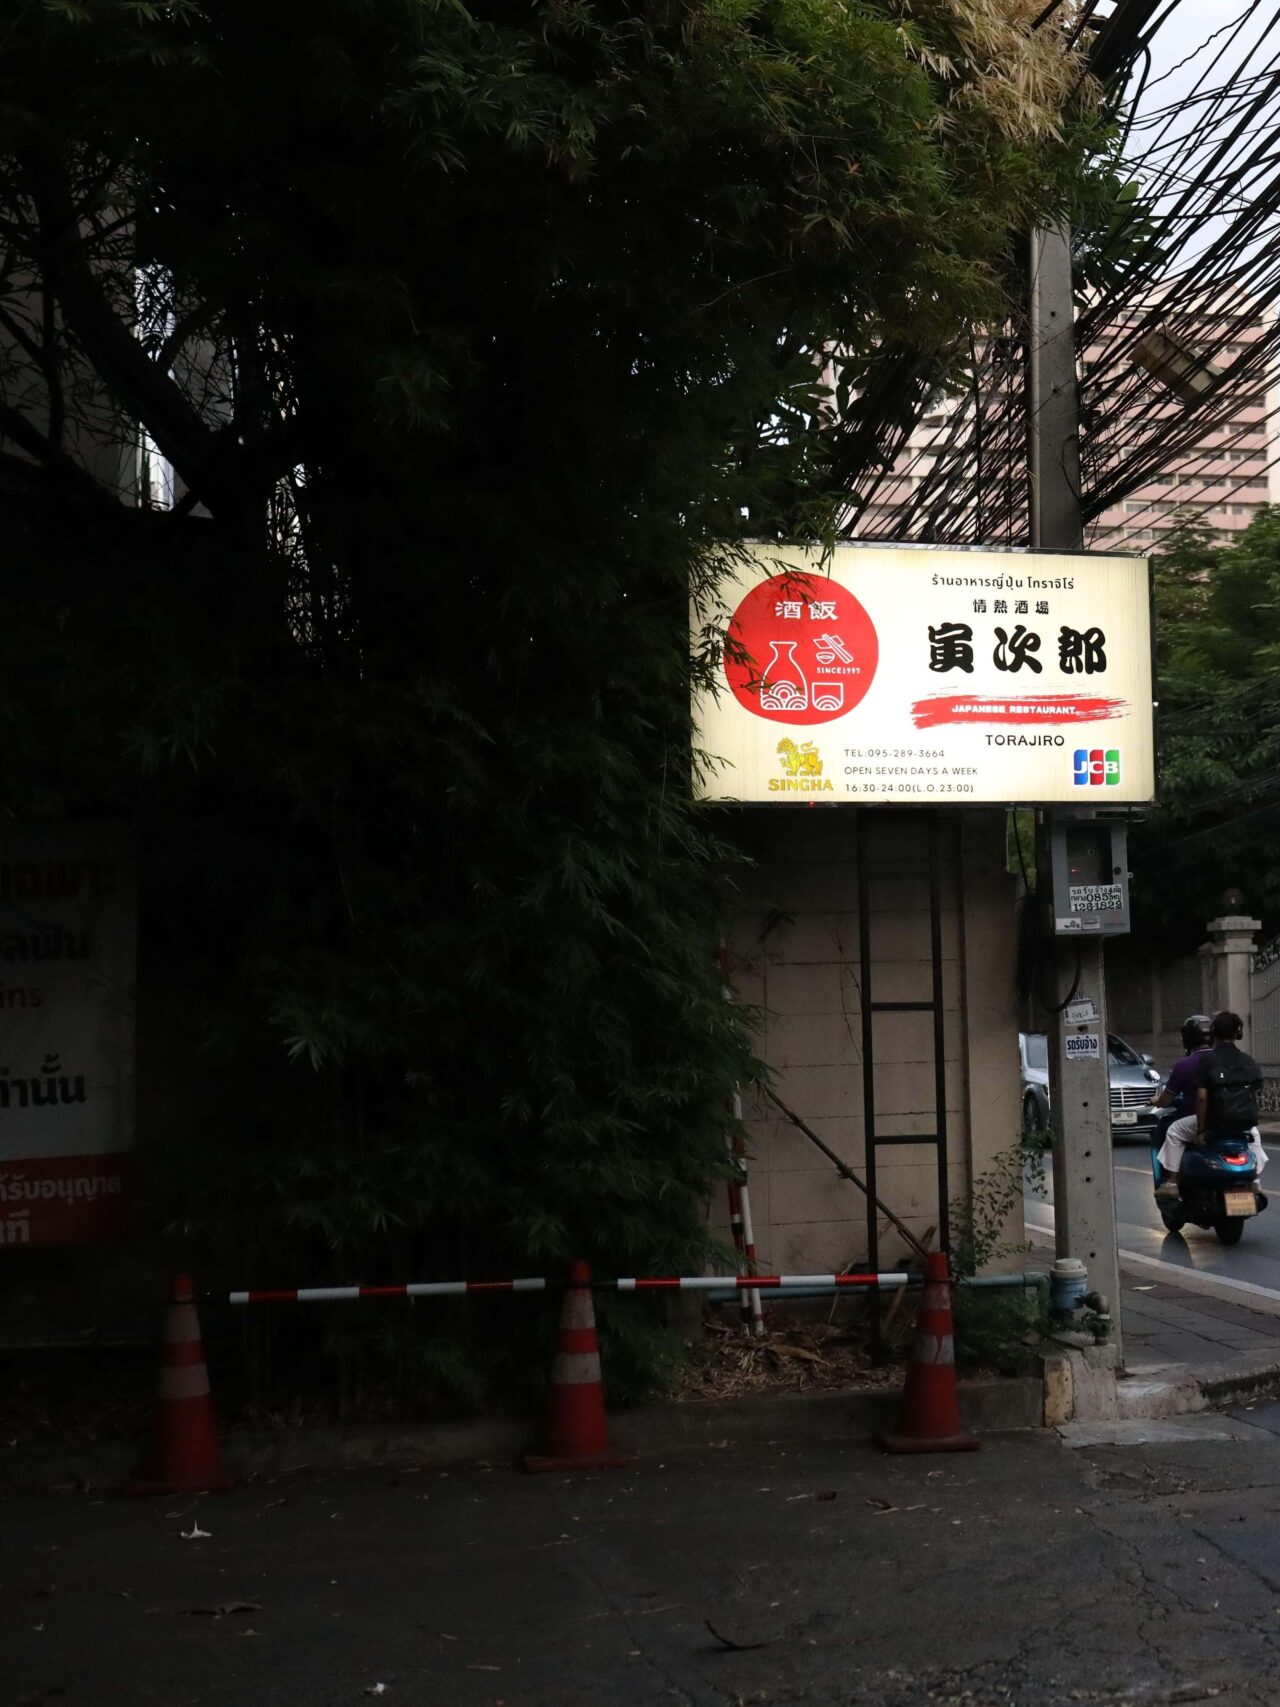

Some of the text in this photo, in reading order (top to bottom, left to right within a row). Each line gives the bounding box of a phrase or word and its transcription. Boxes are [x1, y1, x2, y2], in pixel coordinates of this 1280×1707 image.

[932, 572, 1075, 591] ร้านอาหารญี่ปุ่น โทราจิโร่
[972, 598, 1050, 615] 情熱酒場
[927, 621, 1107, 675] 寅次郎
[951, 704, 1076, 715] JAPANESE RESTAURANT
[985, 734, 1065, 747] TORAJIRO
[844, 766, 979, 776] OPEN SEVEN DAYS A WEEK
[1073, 759, 1119, 776] JCB
[767, 778, 834, 792] SINGHA
[1086, 893, 1109, 902] 085
[1066, 1035, 1098, 1050] รถรับจ้าง
